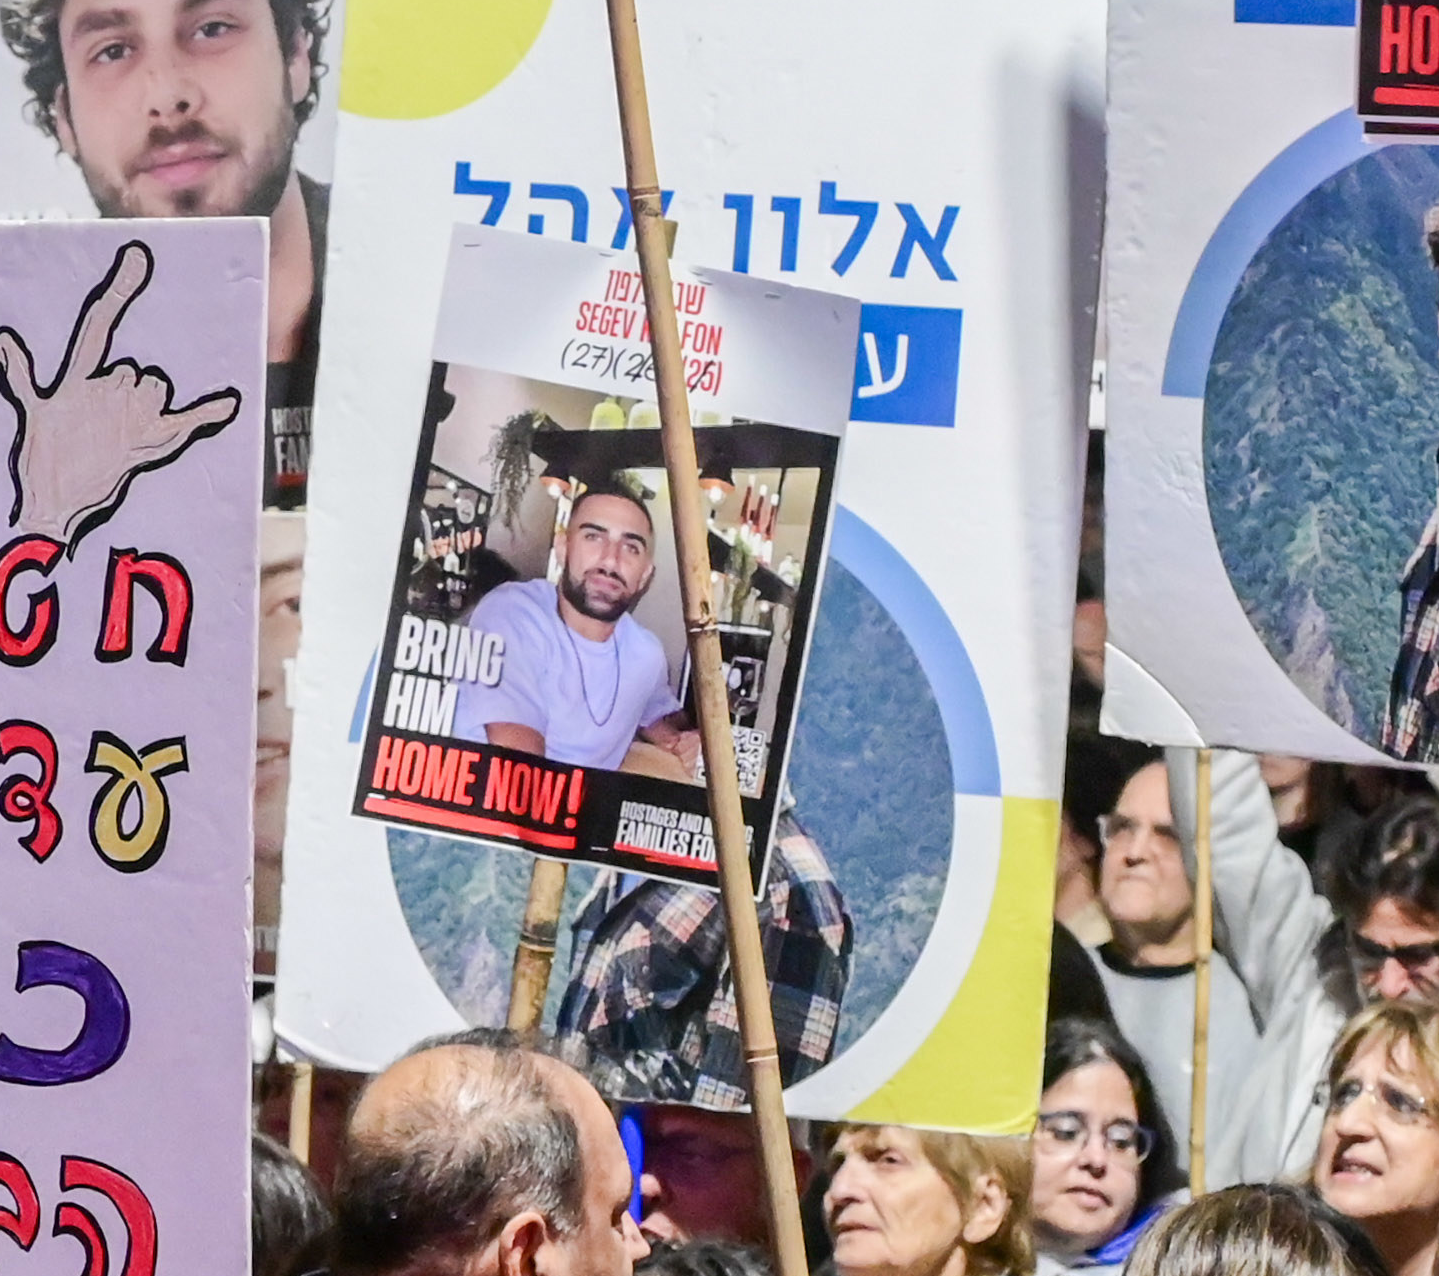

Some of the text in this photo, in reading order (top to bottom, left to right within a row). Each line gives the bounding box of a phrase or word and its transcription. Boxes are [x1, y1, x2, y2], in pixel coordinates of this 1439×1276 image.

[723, 182, 960, 283] אלון
[575, 301, 633, 341] SEGEV
[561, 338, 613, 377] (27)
[393, 617, 506, 686] BRING
[385, 674, 458, 735] HIM
[373, 736, 584, 828] HOME NOW!
[617, 820, 689, 856] FAMILIES
